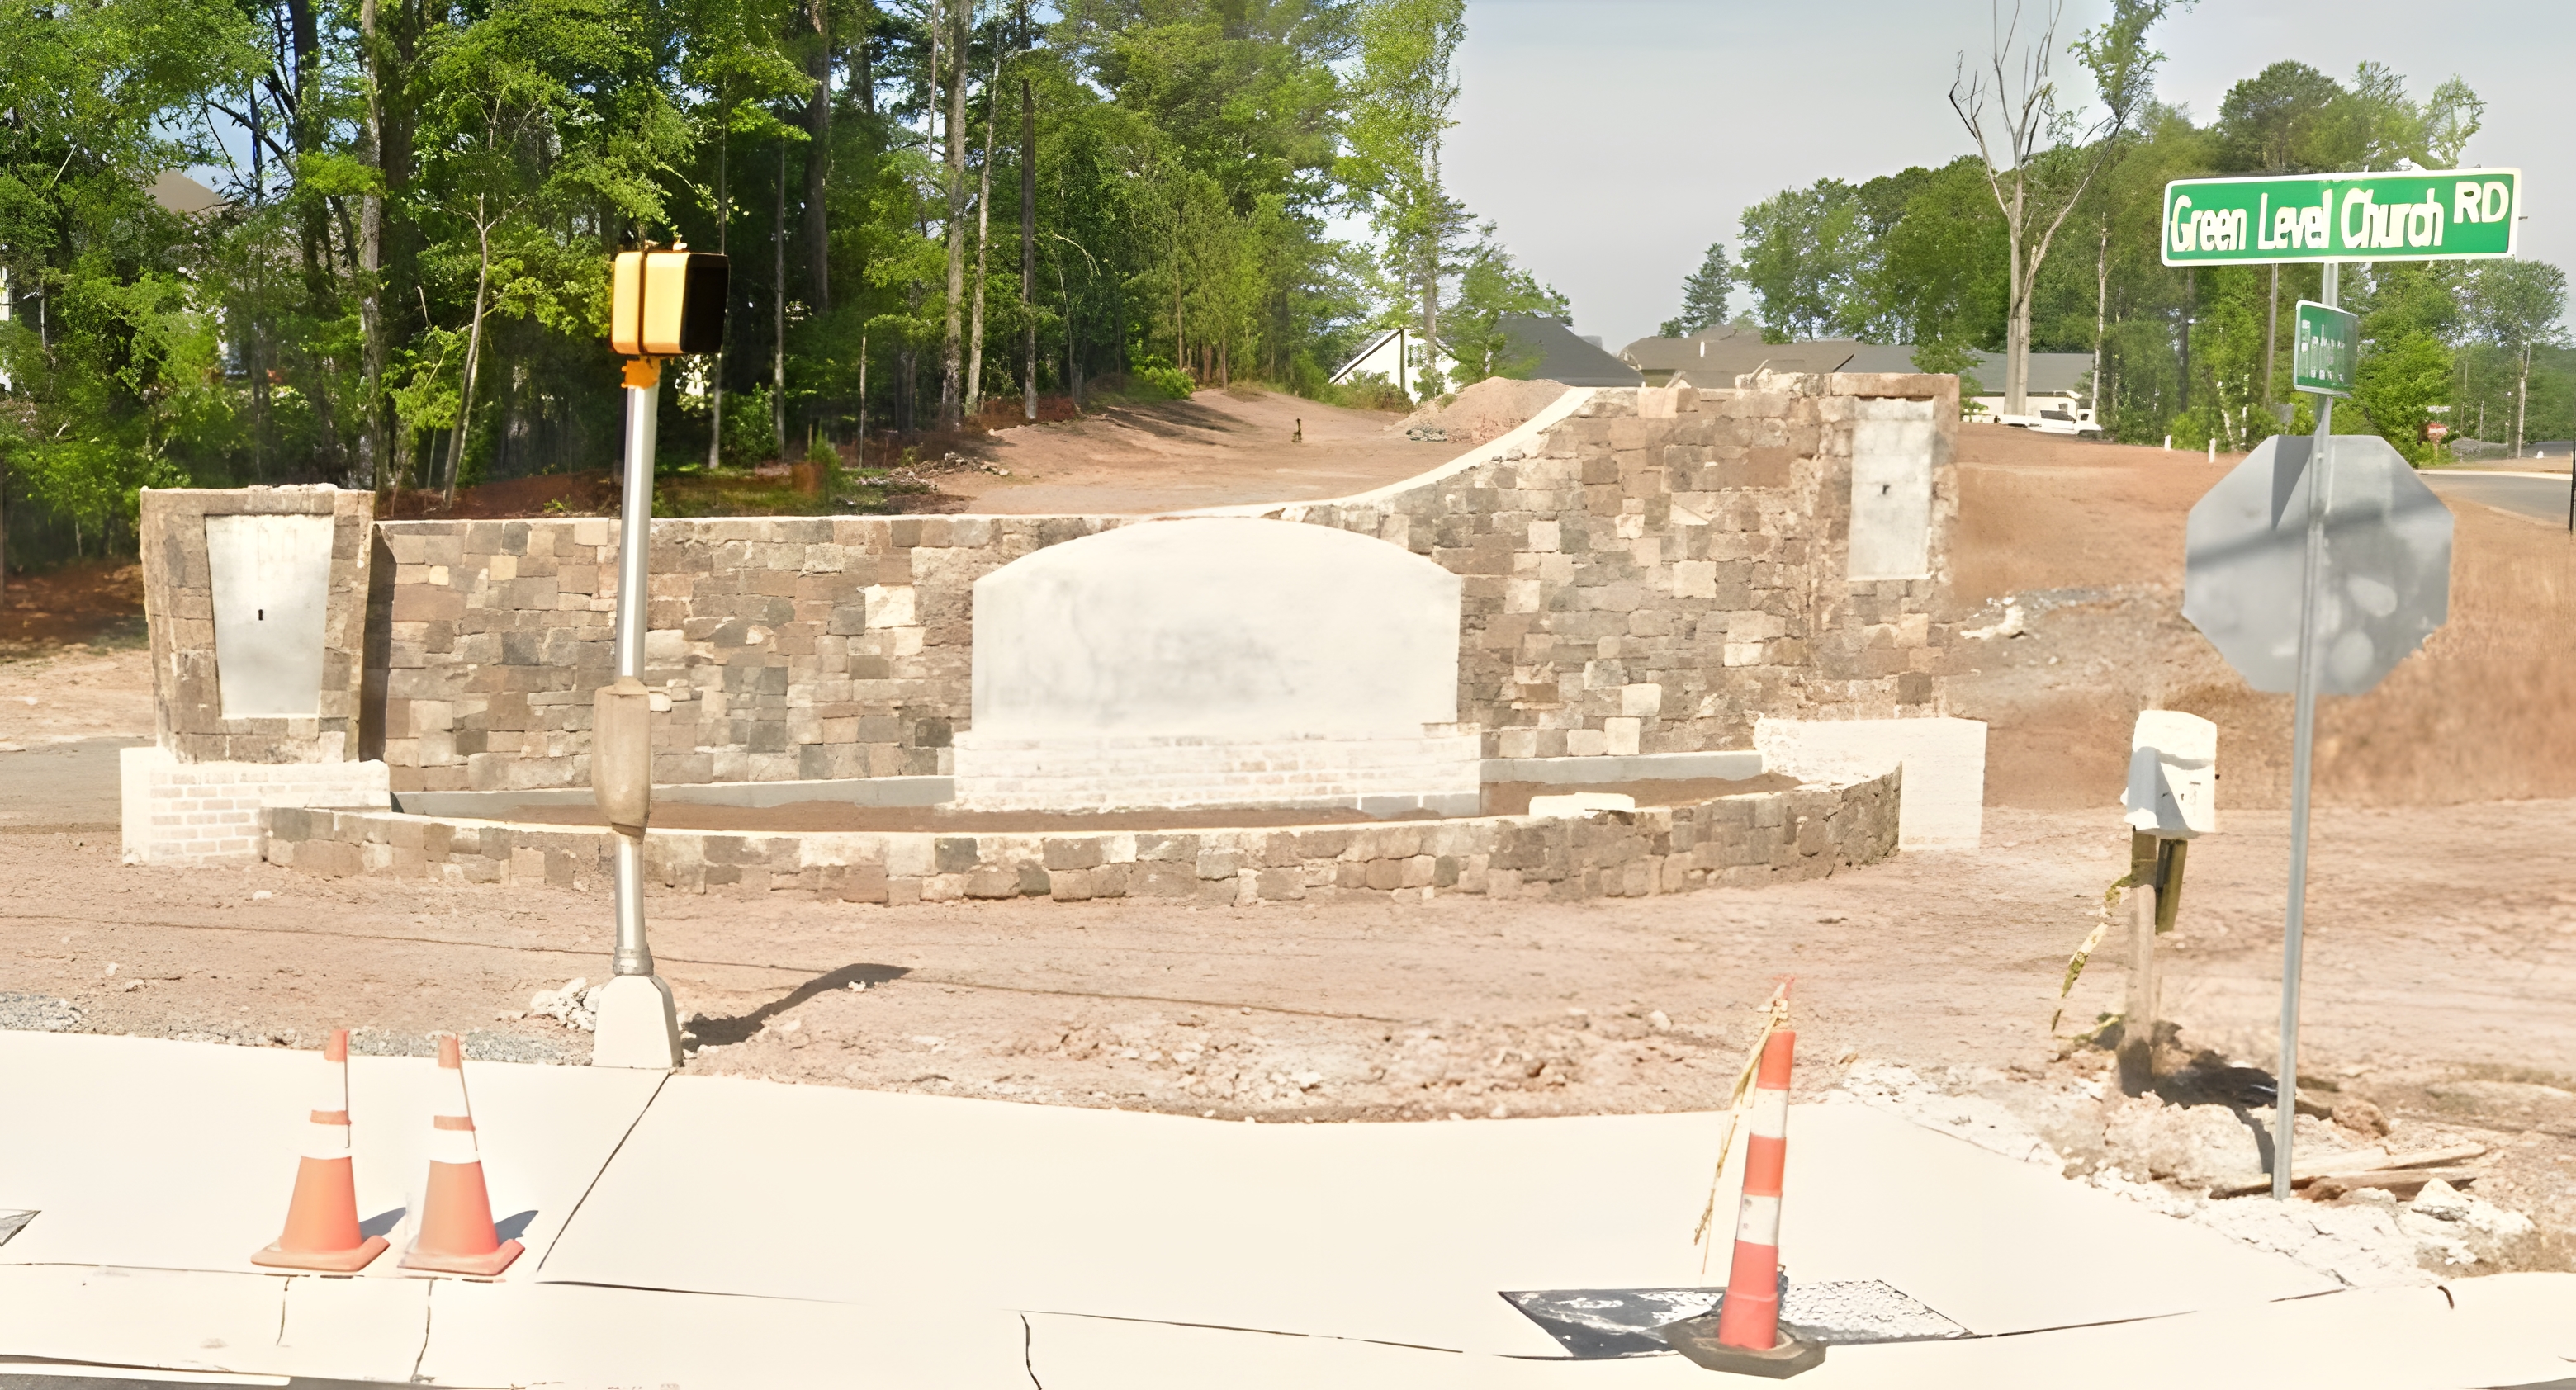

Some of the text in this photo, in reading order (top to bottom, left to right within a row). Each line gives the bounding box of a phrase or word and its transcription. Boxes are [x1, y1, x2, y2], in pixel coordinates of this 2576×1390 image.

[2171, 181, 2509, 252] Green Level Church RD
